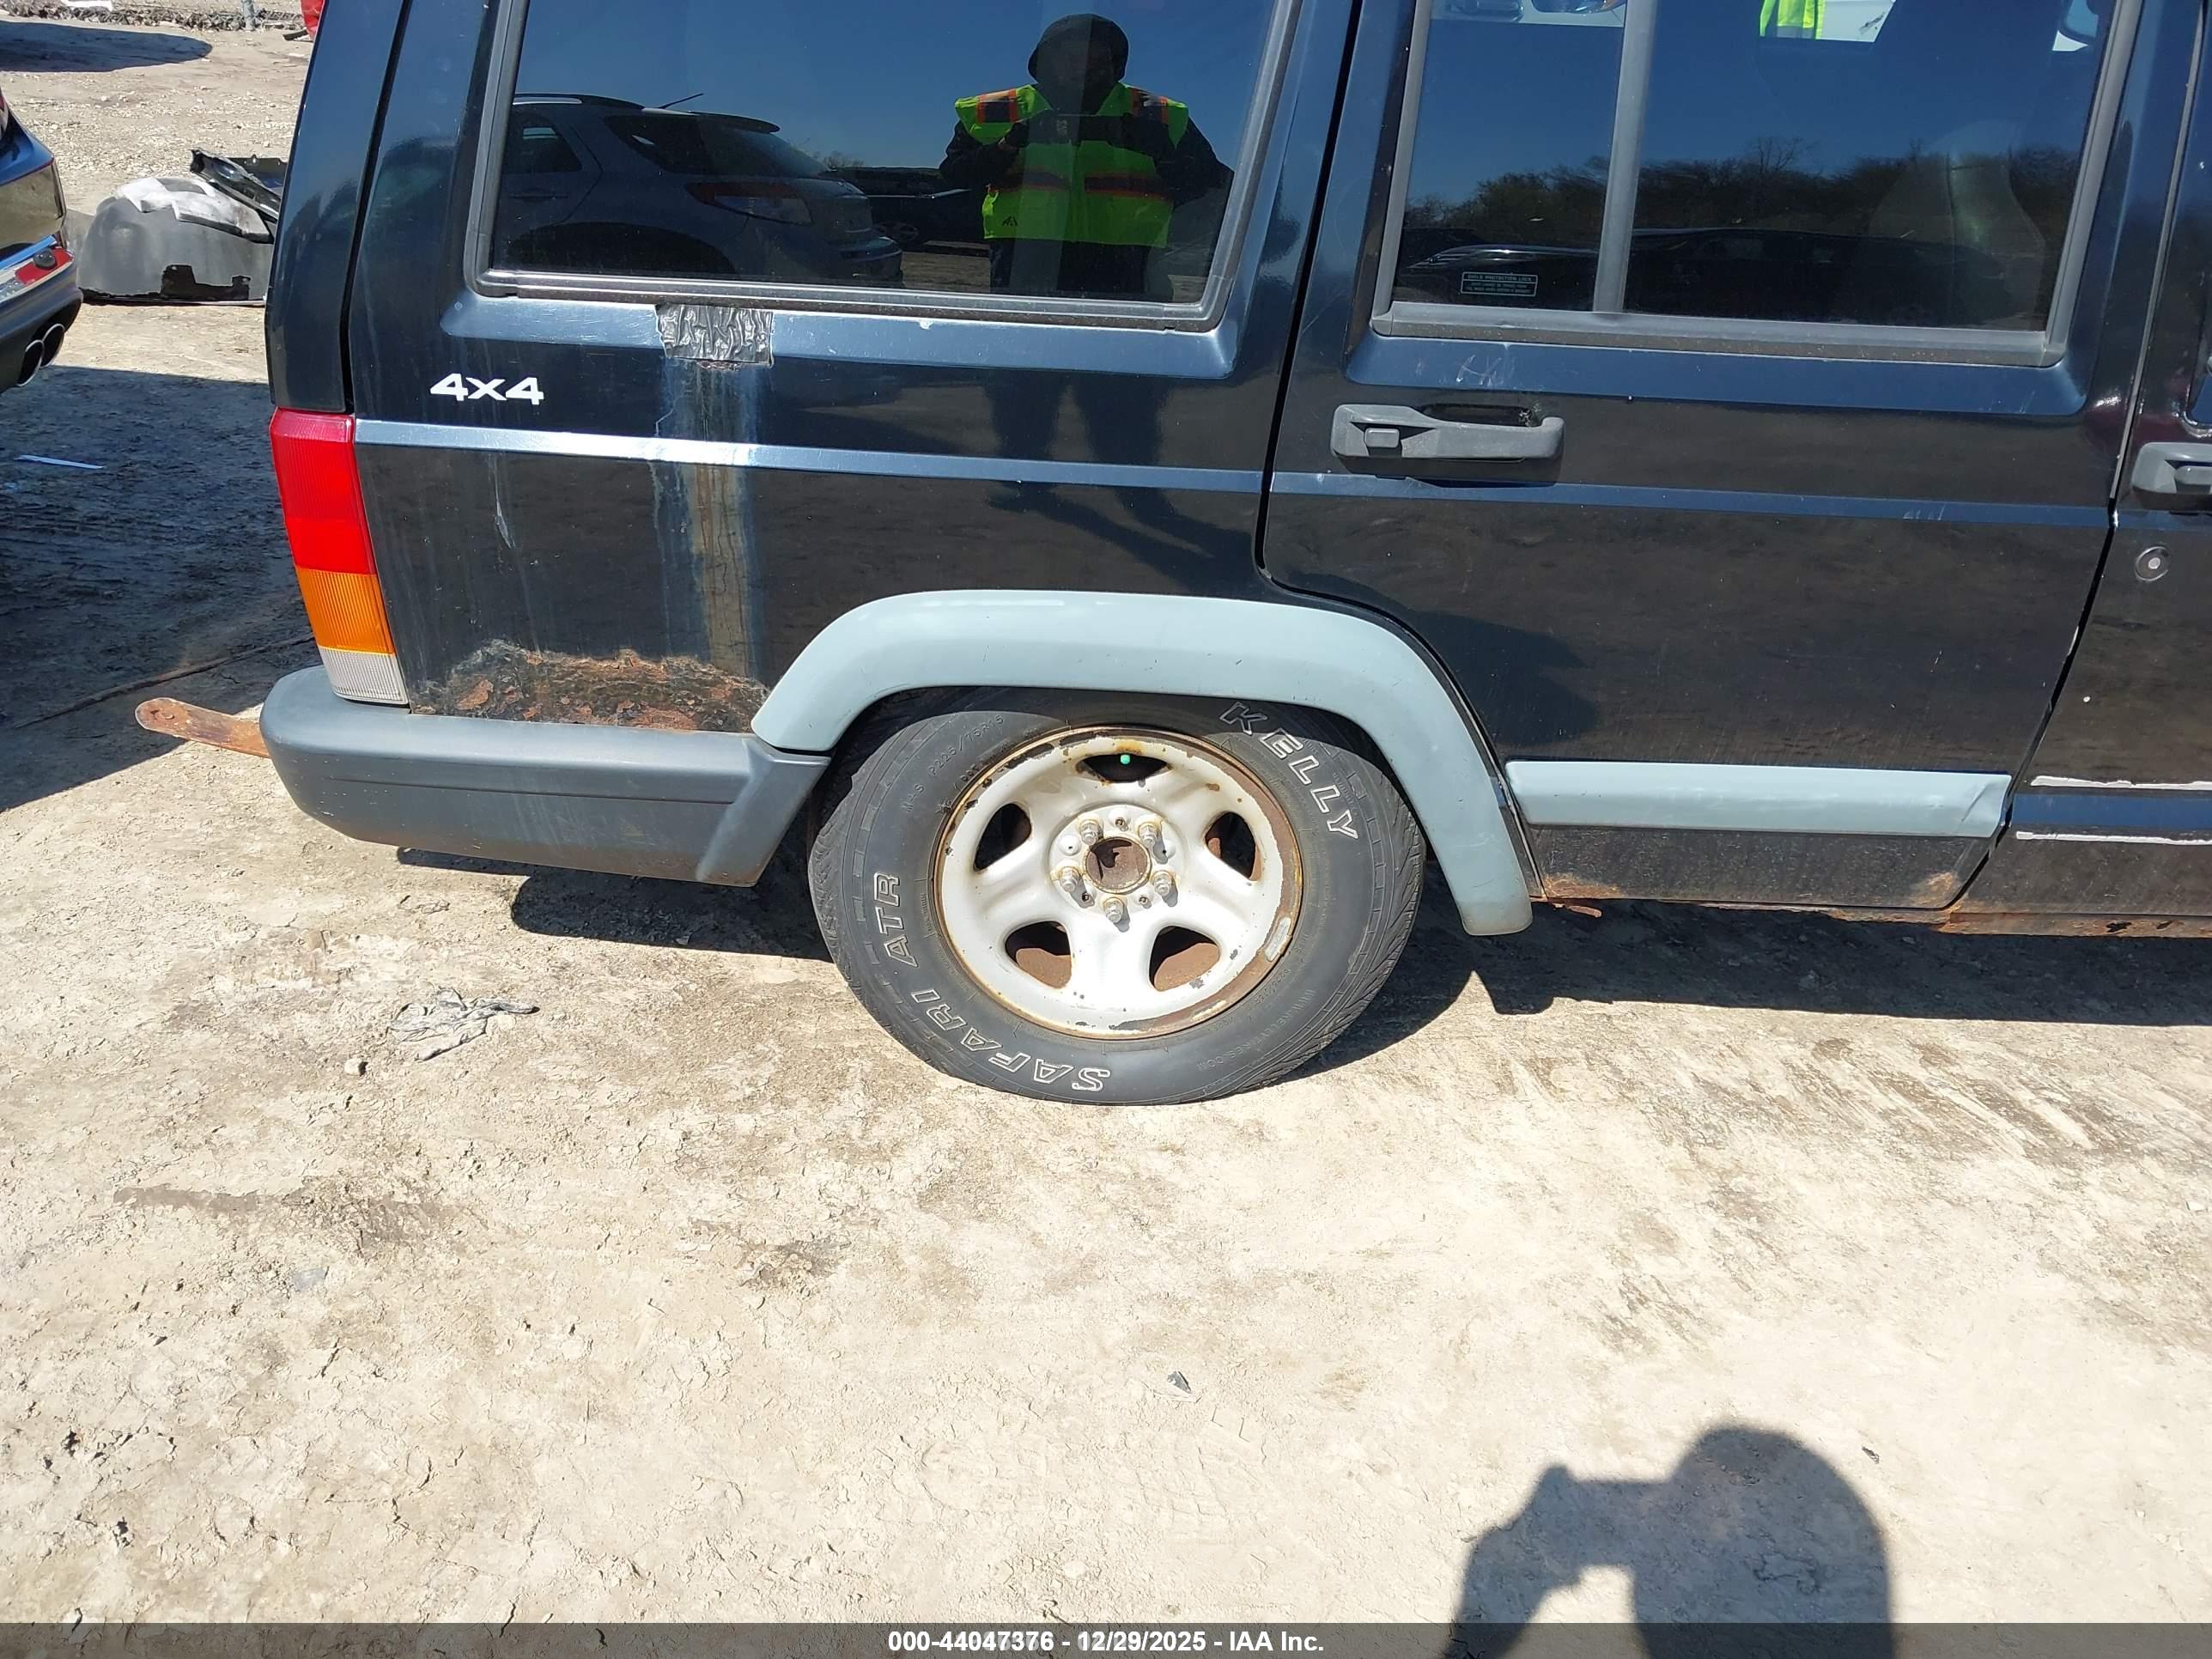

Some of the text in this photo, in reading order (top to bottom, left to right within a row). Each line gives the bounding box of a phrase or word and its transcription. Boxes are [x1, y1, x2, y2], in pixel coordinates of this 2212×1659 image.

[1219, 702, 1358, 840] KELLY
[873, 872, 1111, 1092] SAFARI ATR
